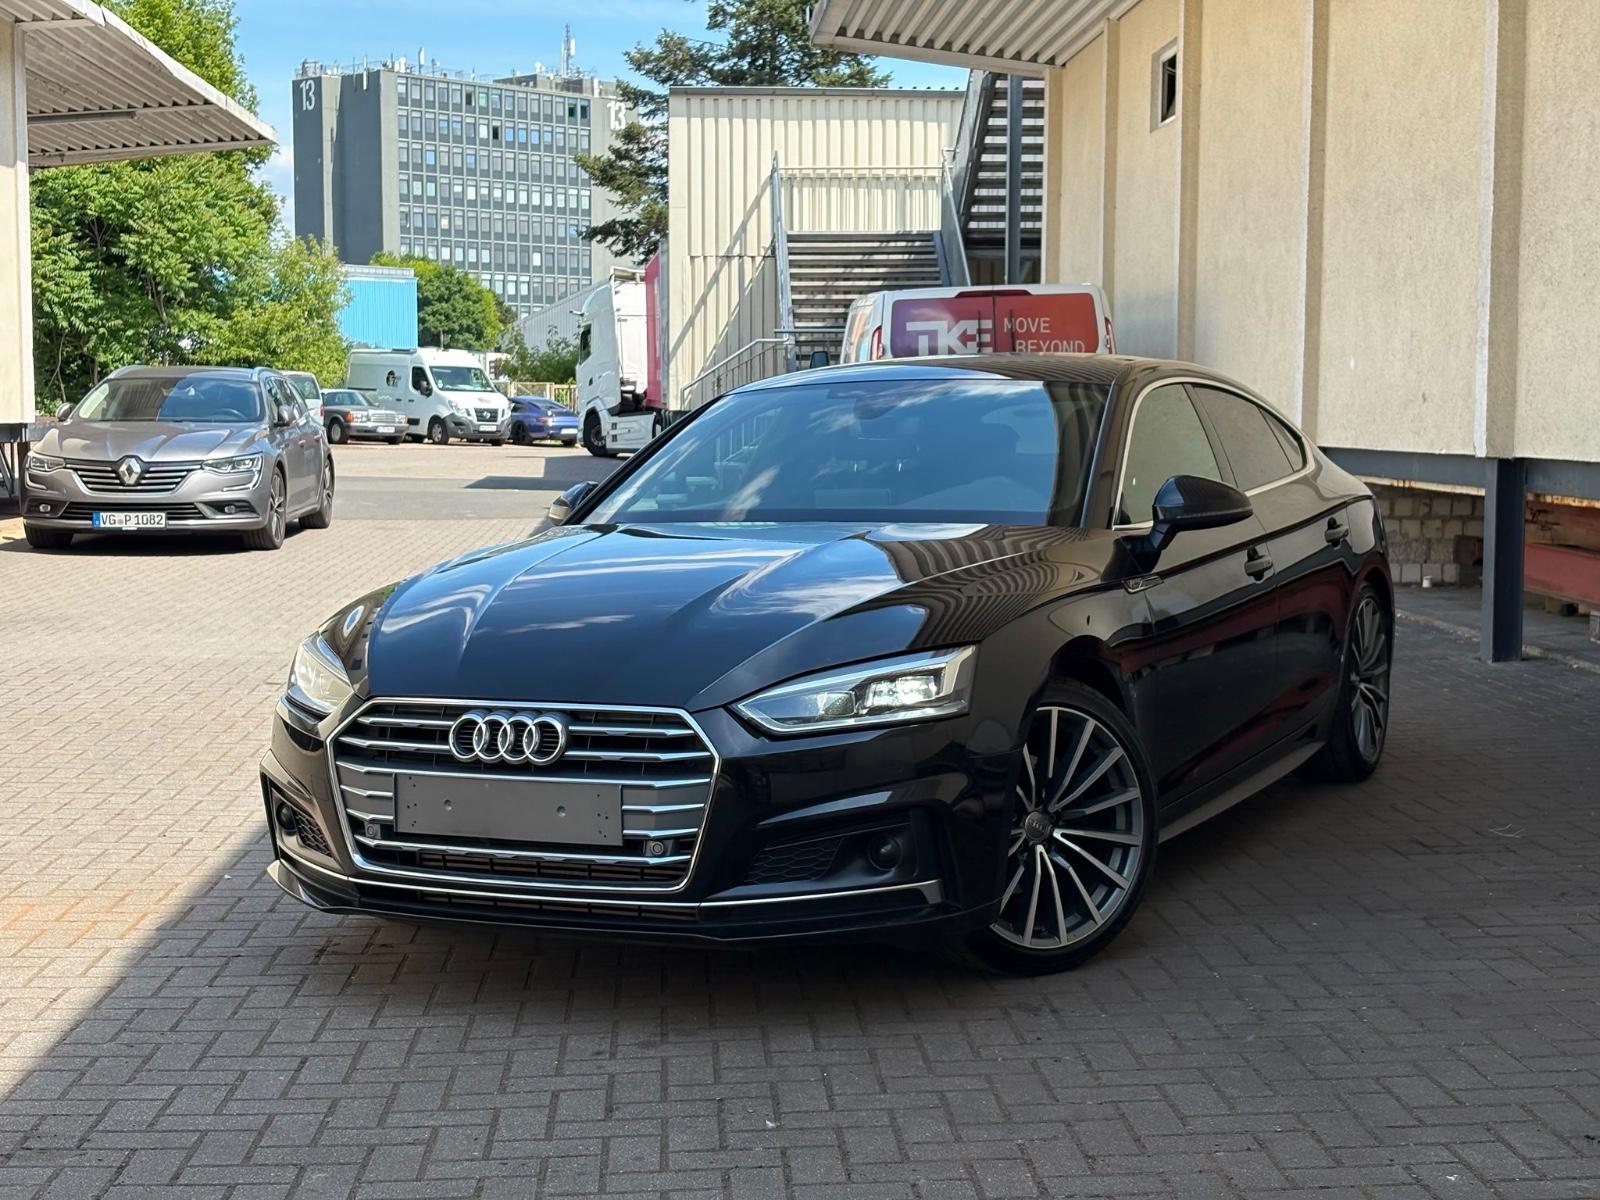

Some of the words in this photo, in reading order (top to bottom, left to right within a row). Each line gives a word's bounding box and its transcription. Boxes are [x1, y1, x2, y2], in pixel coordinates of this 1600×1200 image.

[299, 80, 315, 111] 13
[607, 101, 626, 131] 13
[1003, 317, 1051, 333] MOVE
[906, 320, 993, 356] TKE
[1015, 340, 1085, 353] BEYOND
[101, 514, 116, 525] VG
[124, 514, 131, 525] P
[134, 514, 163, 525] 1082
